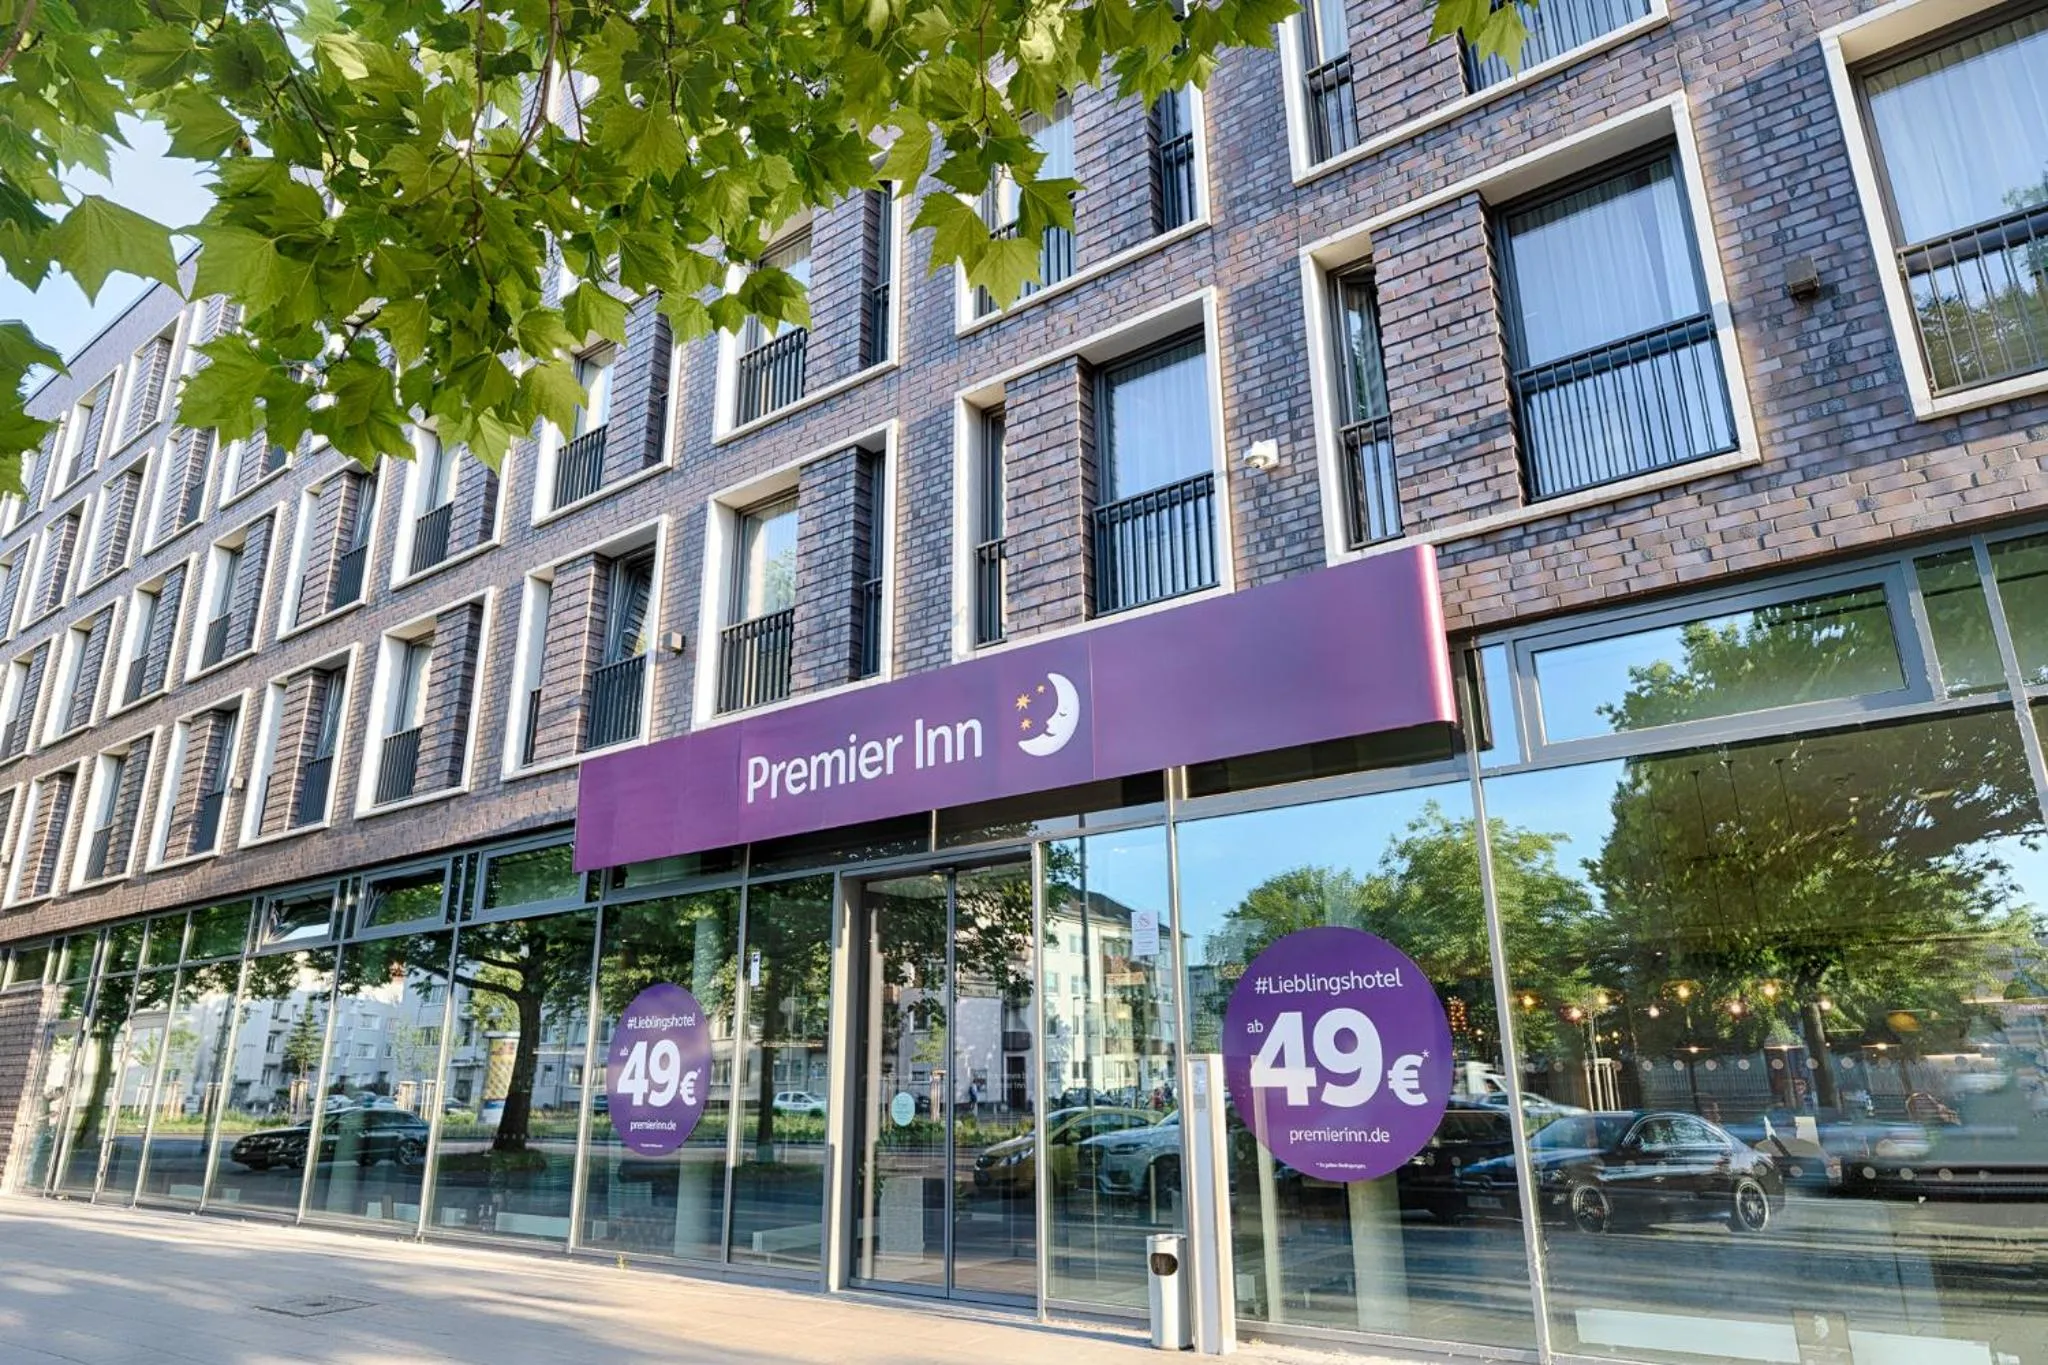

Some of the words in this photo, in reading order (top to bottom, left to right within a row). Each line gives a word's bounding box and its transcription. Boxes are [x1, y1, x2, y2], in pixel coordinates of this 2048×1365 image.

[747, 733, 904, 804] Premier
[915, 718, 983, 770] Inn
[1254, 967, 1403, 996] #Lieblingshotel
[627, 1012, 696, 1031] #Lieblingshotel
[1247, 1019, 1264, 1034] ab
[629, 1119, 677, 1132] premierinn.de
[1289, 1127, 1390, 1145] premierinn.de
